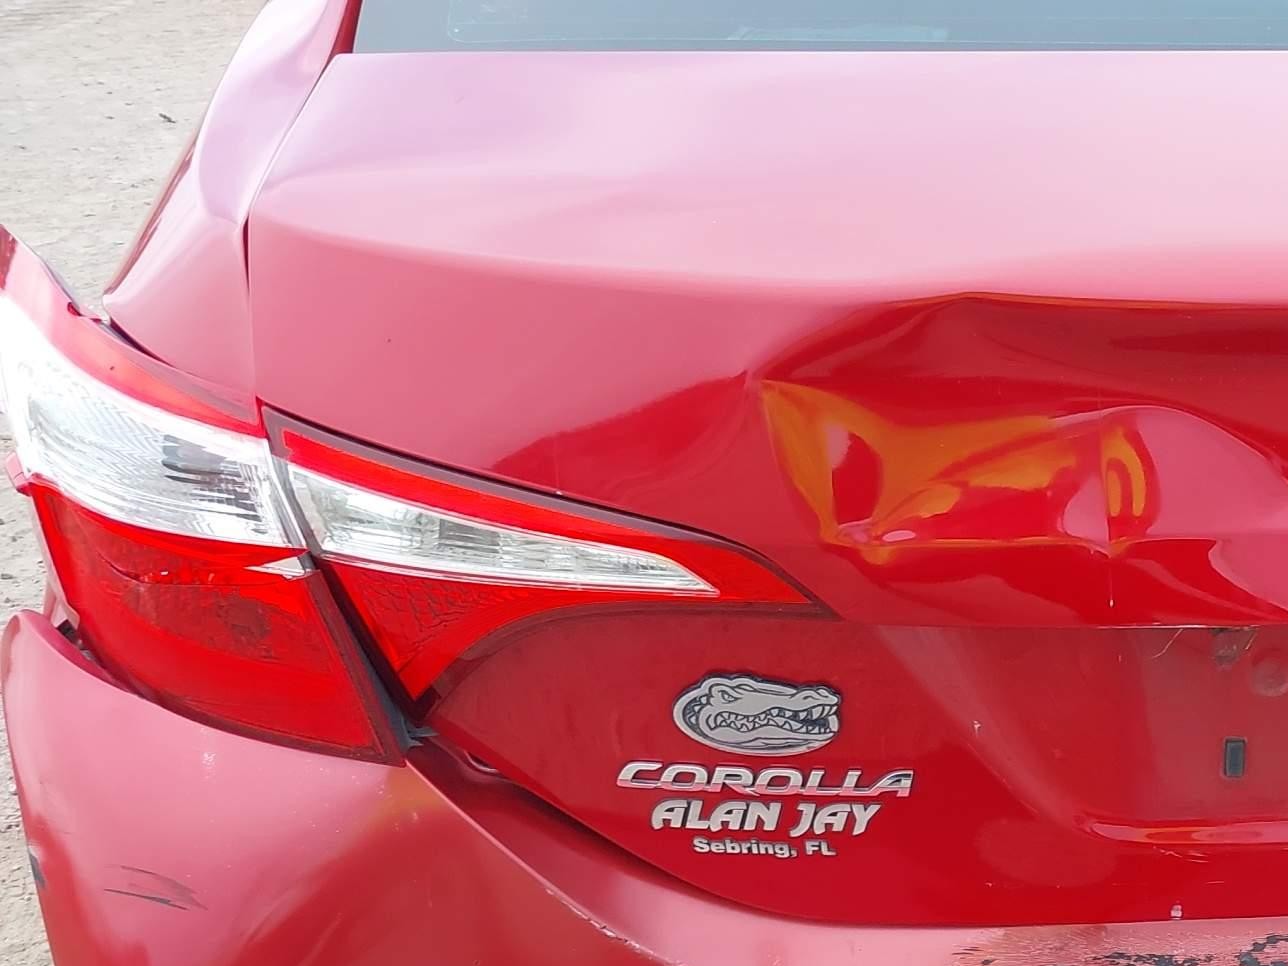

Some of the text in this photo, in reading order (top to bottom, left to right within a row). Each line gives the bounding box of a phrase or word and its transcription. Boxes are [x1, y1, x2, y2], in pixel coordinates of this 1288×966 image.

[616, 760, 914, 797] COROLLA
[651, 799, 881, 837] ALAN JAY
[693, 836, 836, 858] Sebring, FL
